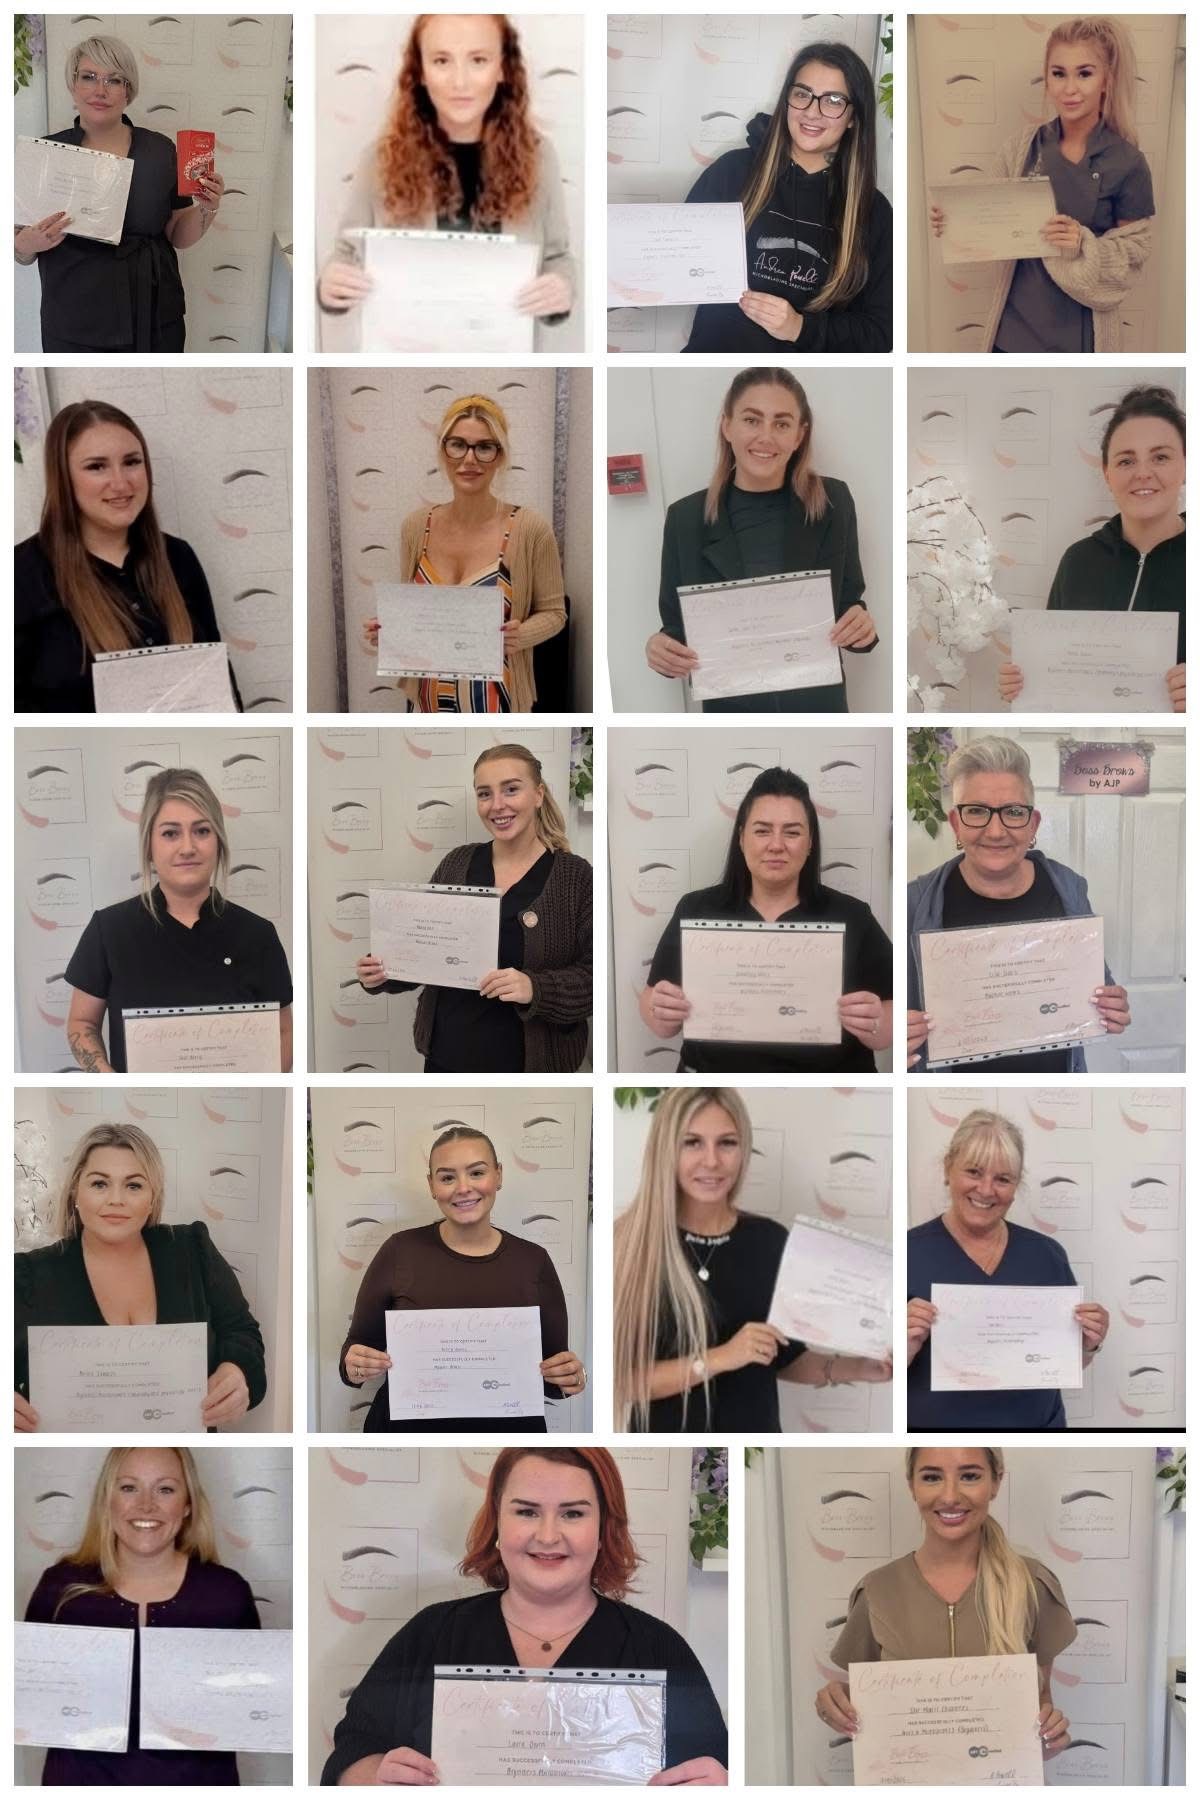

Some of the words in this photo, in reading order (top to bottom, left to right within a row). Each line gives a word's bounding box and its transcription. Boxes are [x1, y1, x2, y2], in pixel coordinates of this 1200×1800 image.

[1073, 764, 1099, 775] Boss
[1103, 762, 1135, 776] Brows
[1089, 778, 1101, 789] by
[1103, 779, 1121, 788] AJP
